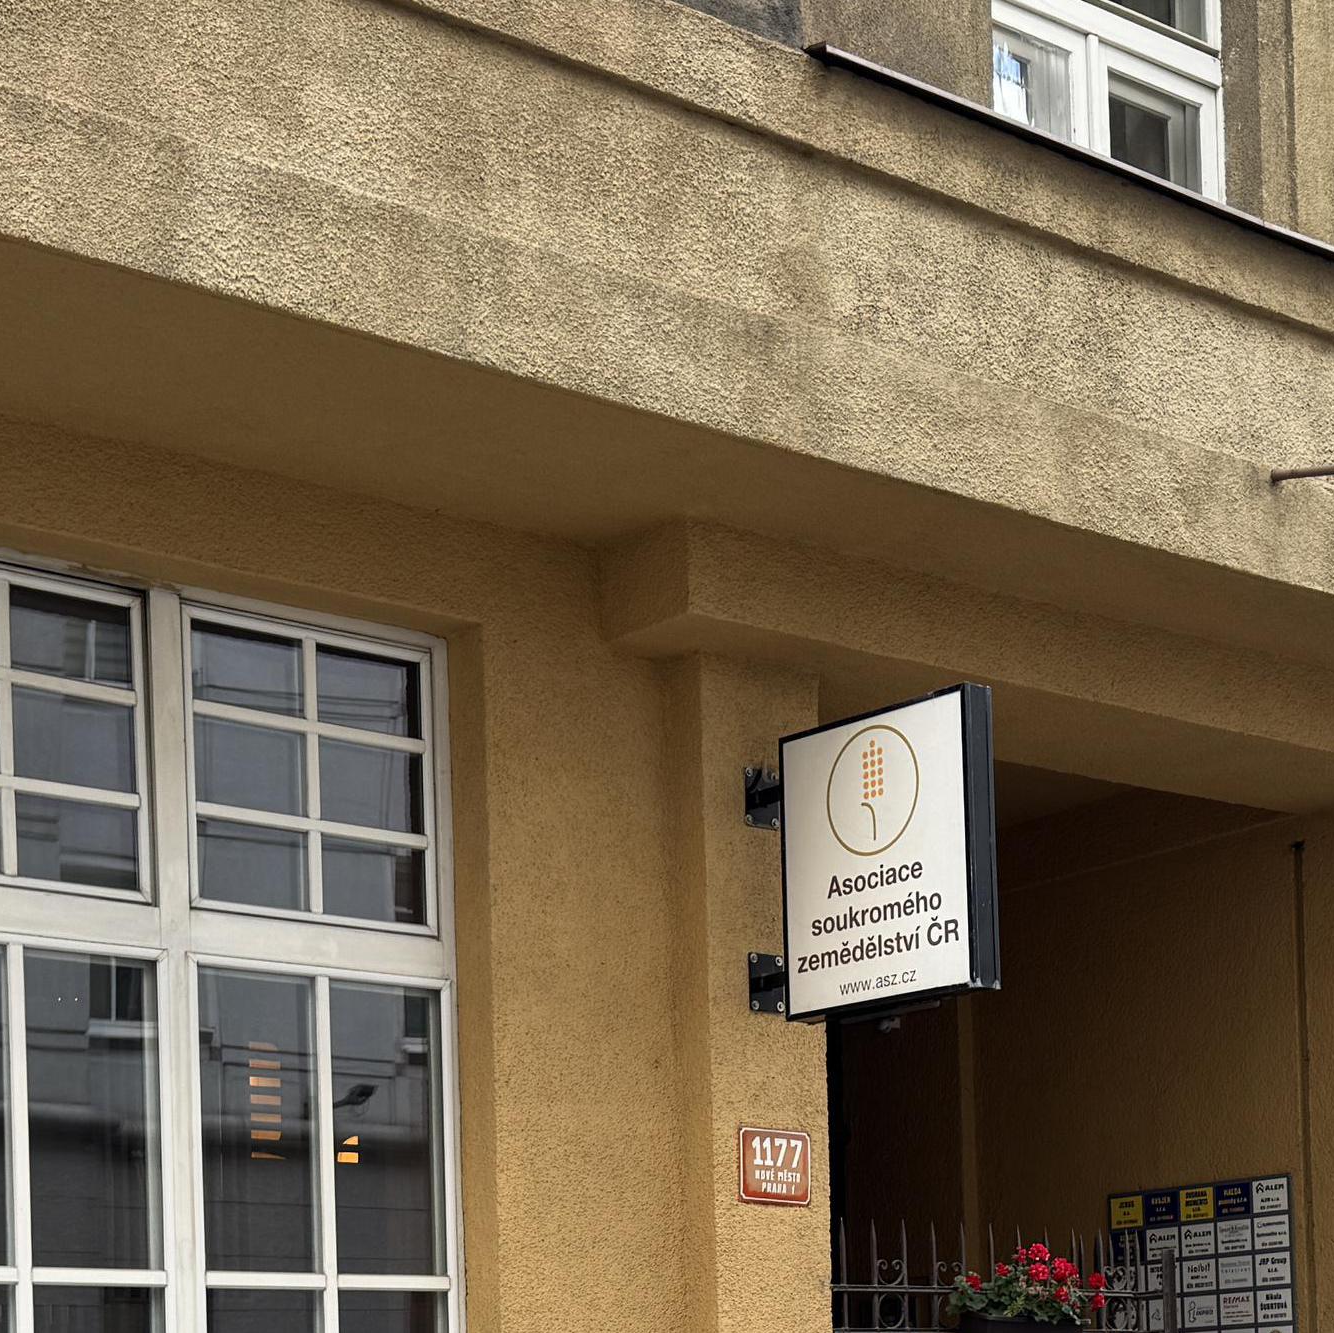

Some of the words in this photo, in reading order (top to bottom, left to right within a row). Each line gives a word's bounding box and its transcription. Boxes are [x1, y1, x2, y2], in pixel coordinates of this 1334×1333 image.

[827, 859, 923, 899] Asociace
[811, 890, 942, 937] soukromého
[797, 925, 921, 974] zemědělství
[927, 917, 959, 947] ČR
[839, 969, 917, 997] www.asz.cz
[752, 1136, 802, 1168] 1177
[755, 1169, 775, 1180] NOVÉ
[778, 1169, 800, 1183] MĚSTO
[761, 1182, 787, 1194] PRAHA
[791, 1184, 796, 1195] 1
